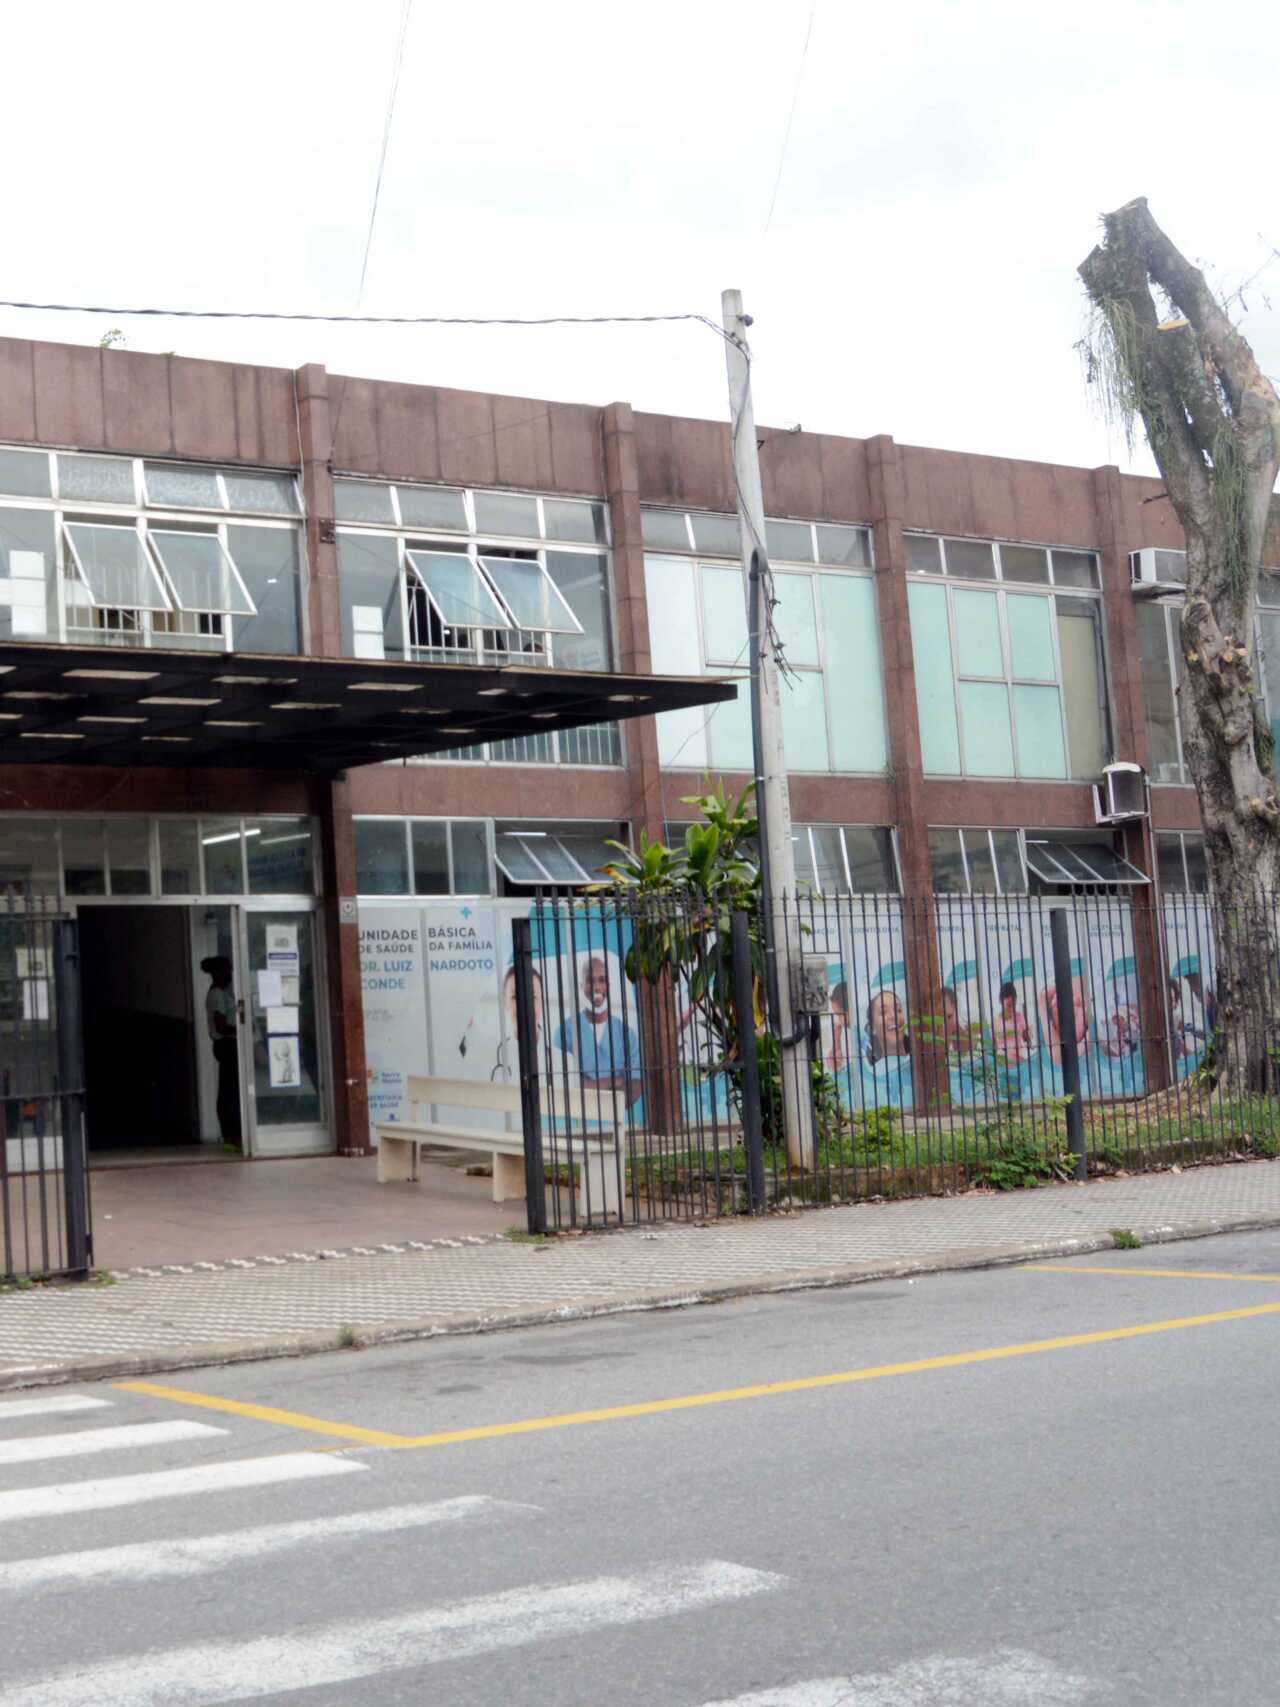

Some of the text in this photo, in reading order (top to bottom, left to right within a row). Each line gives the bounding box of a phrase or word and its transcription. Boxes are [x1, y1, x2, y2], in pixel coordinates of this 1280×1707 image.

[428, 925, 476, 938] BÁSICA
[376, 941, 415, 954] SAÚDE
[429, 941, 444, 951] DA
[448, 939, 493, 951] FAMÍLIA
[384, 960, 413, 972] LUIZ
[430, 959, 494, 971] NARDOTO
